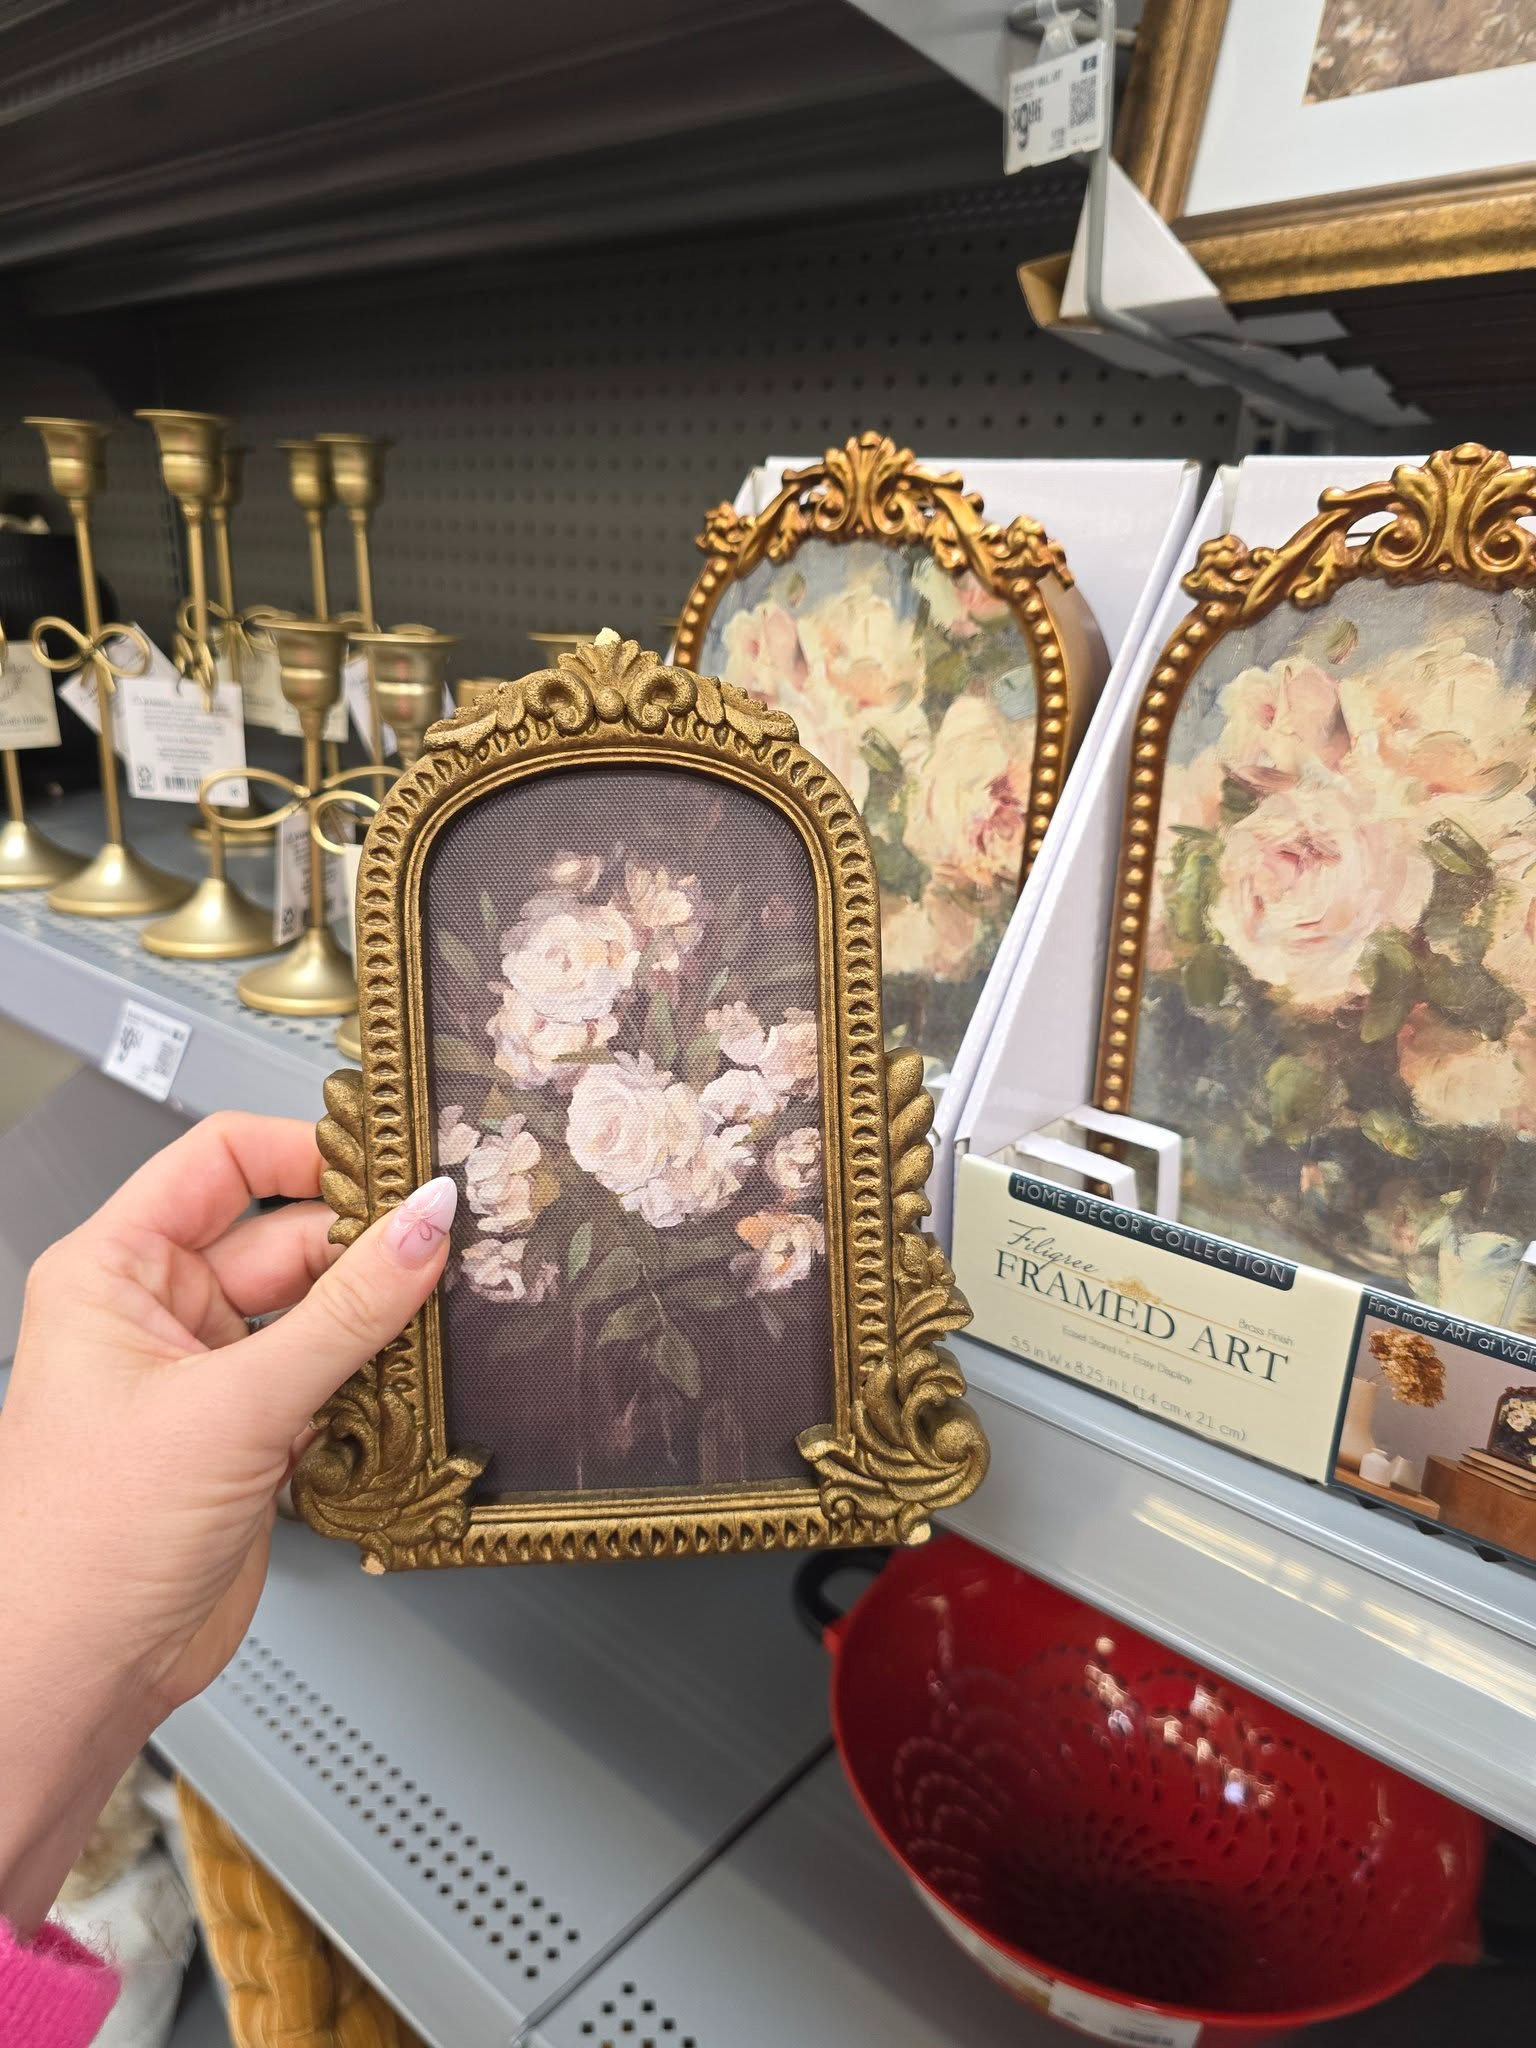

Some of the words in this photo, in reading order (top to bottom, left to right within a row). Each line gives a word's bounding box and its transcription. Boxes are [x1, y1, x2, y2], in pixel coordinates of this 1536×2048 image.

[1007, 1219, 1099, 1272] Filigree
[1015, 1180, 1068, 1210] HOME
[1151, 1225, 1286, 1283] COLLECTION
[993, 1248, 1176, 1340] FRAMED
[1187, 1325, 1289, 1383] ART
[1238, 1318, 1265, 1336] Brass
[1267, 1328, 1295, 1347] Finish
[1368, 1296, 1400, 1318] Find
[1401, 1311, 1440, 1332] more
[1442, 1322, 1476, 1344] ART
[1478, 1336, 1496, 1351] at
[1033, 1345, 1044, 1359] in
[1047, 1350, 1062, 1365] W
[1064, 1360, 1071, 1369] x
[1106, 1375, 1118, 1390] in
[1132, 1384, 1156, 1404] (14
[1160, 1400, 1181, 1415] cm
[1184, 1409, 1191, 1420] x
[1196, 1411, 1214, 1429] 21
[1219, 1424, 1247, 1442] cm)
